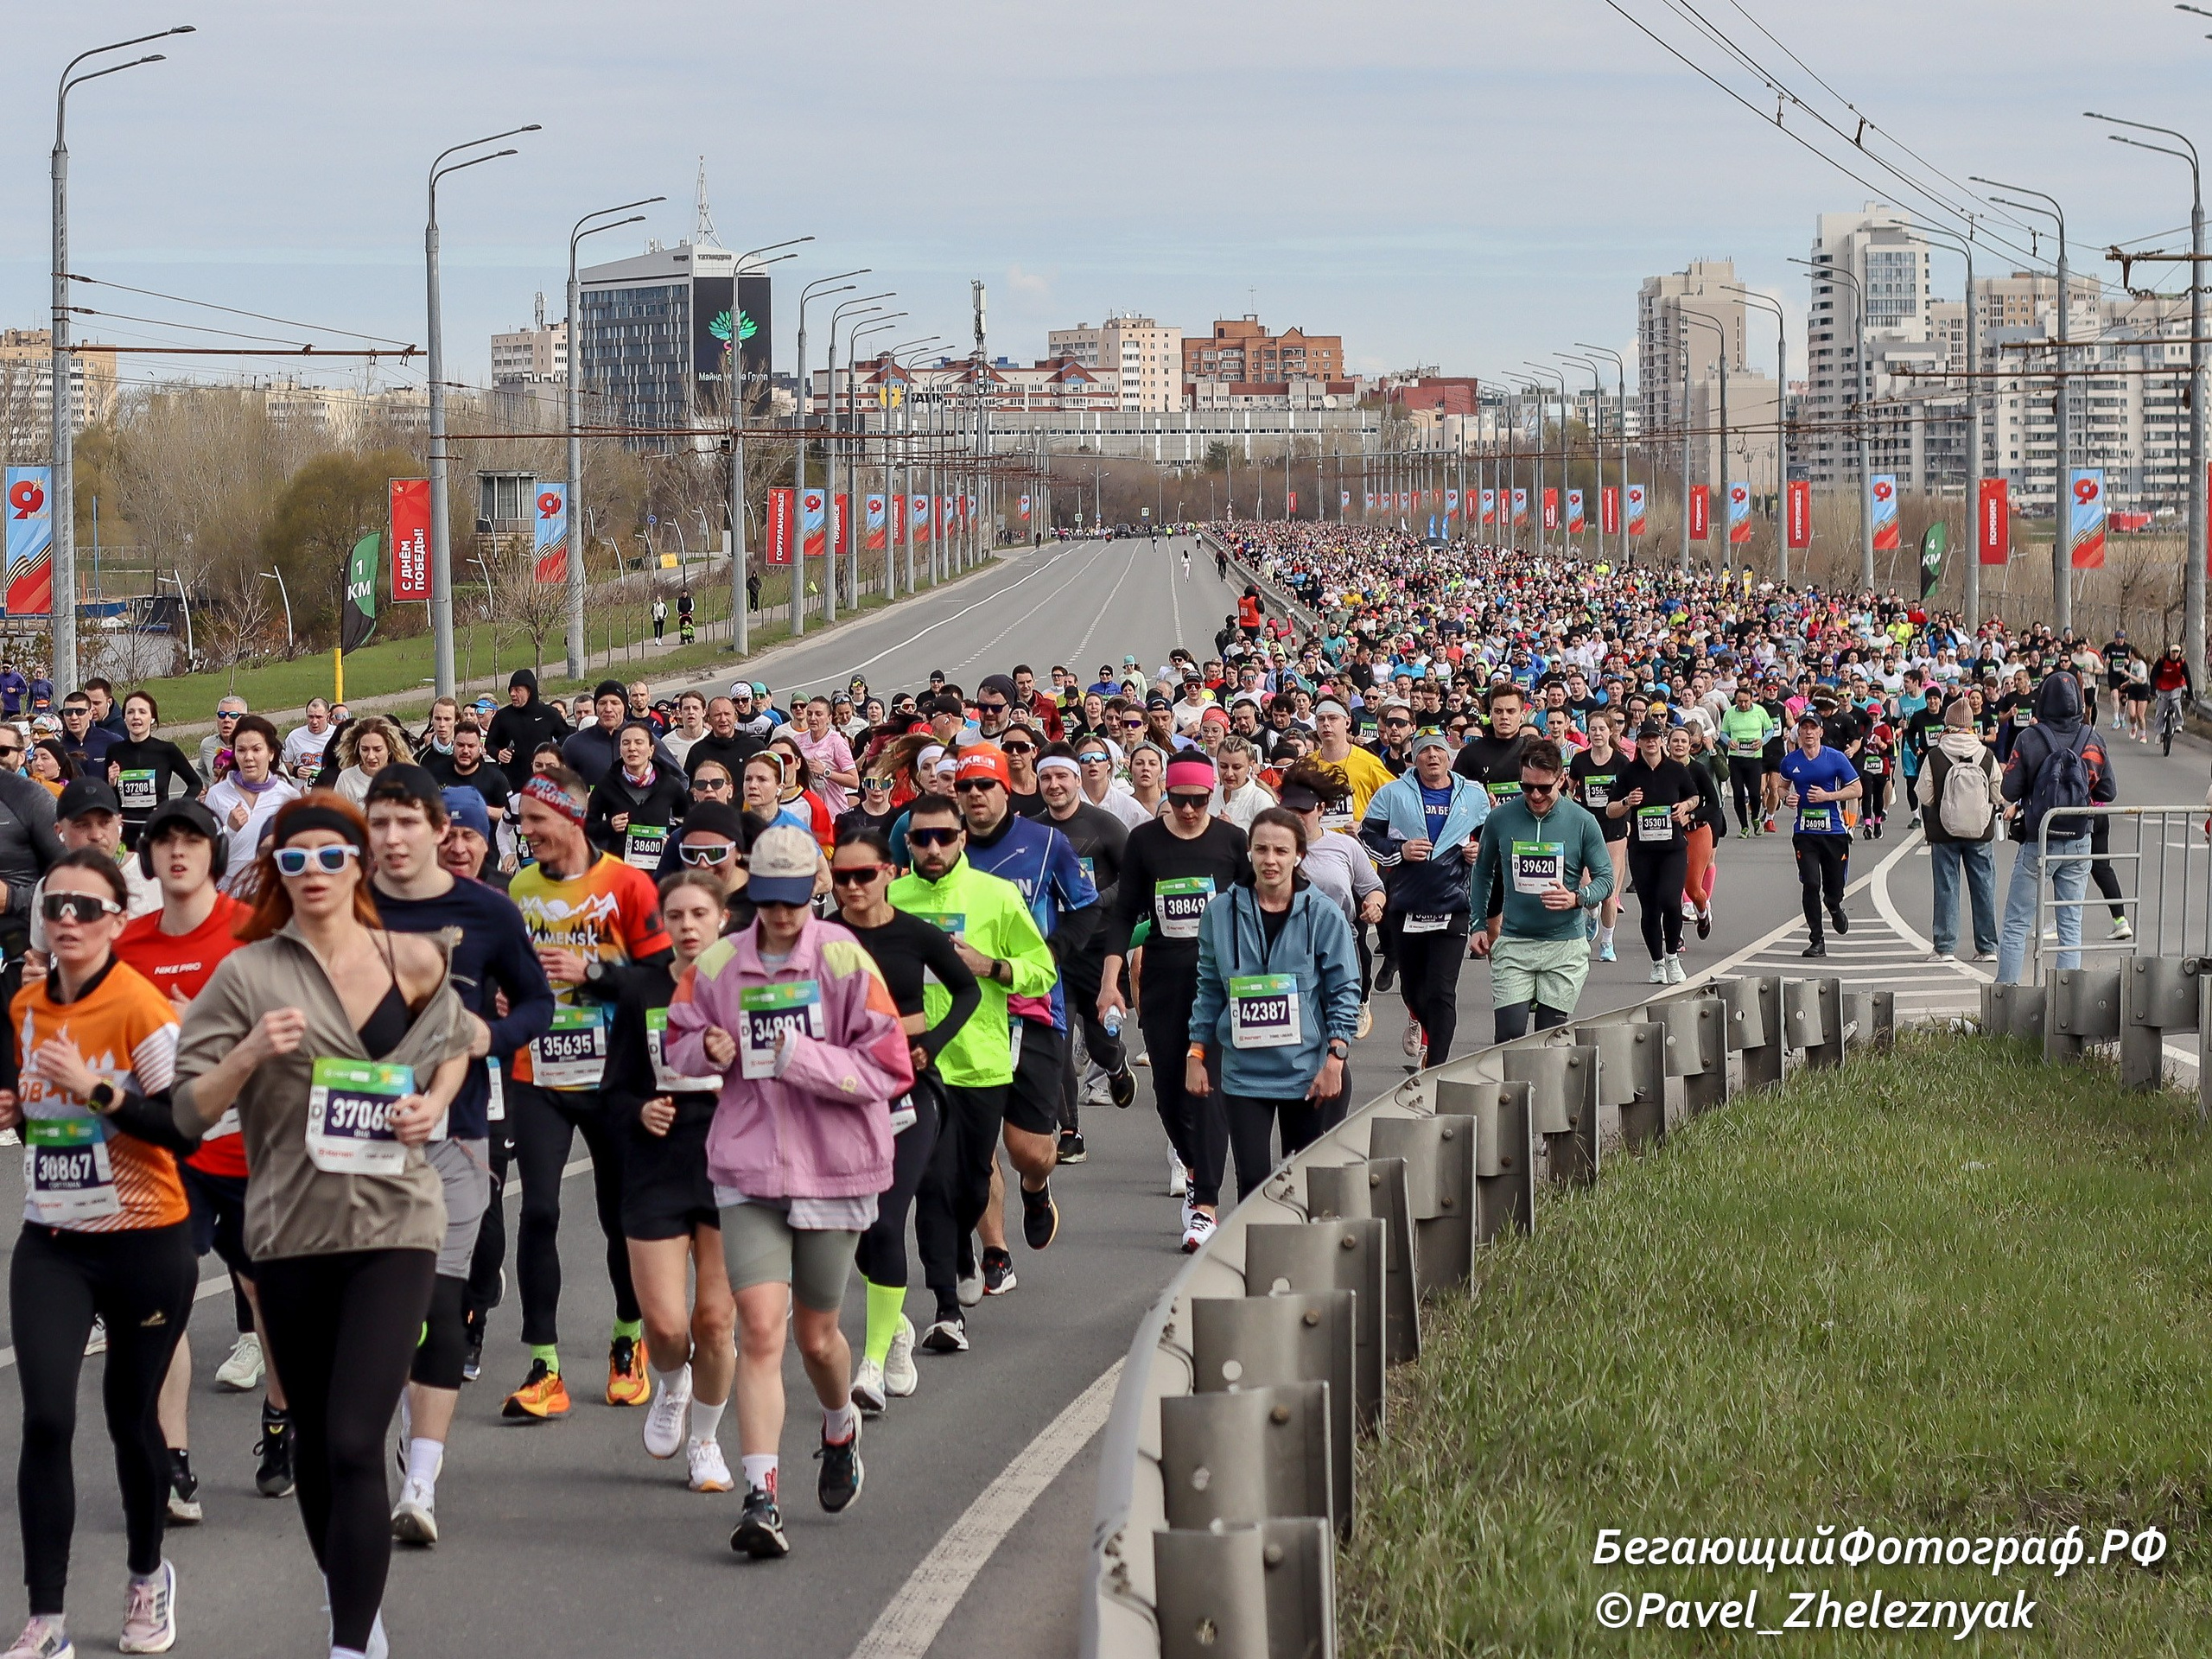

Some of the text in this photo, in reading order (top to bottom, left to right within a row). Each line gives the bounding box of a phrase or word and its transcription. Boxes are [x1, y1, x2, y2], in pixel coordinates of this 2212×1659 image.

[10, 480, 44, 519] 9
[1629, 489, 1642, 503] 9
[1731, 487, 1746, 504] 9
[1873, 481, 1892, 502] 9
[2073, 479, 2099, 505] 9
[537, 493, 562, 519] 9
[804, 495, 822, 513] 9
[868, 499, 882, 514] 9
[1928, 538, 1936, 550] 4
[356, 560, 363, 575] 1
[398, 540, 413, 591] С ДНЁМ
[414, 528, 425, 591] ПОБЕДЫ!
[124, 782, 149, 793] 37208
[1438, 805, 1450, 816] БЕ
[1643, 817, 1666, 828] 35301
[1806, 819, 1825, 828] 36098
[633, 839, 661, 853] 38600
[1514, 859, 1554, 874] D 39620
[1167, 897, 1206, 915] 38849
[154, 962, 202, 975] NIKE PRO
[1241, 1001, 1287, 1021] 42387
[543, 1033, 593, 1057] 35635
[38, 1152, 92, 1184] 30867
